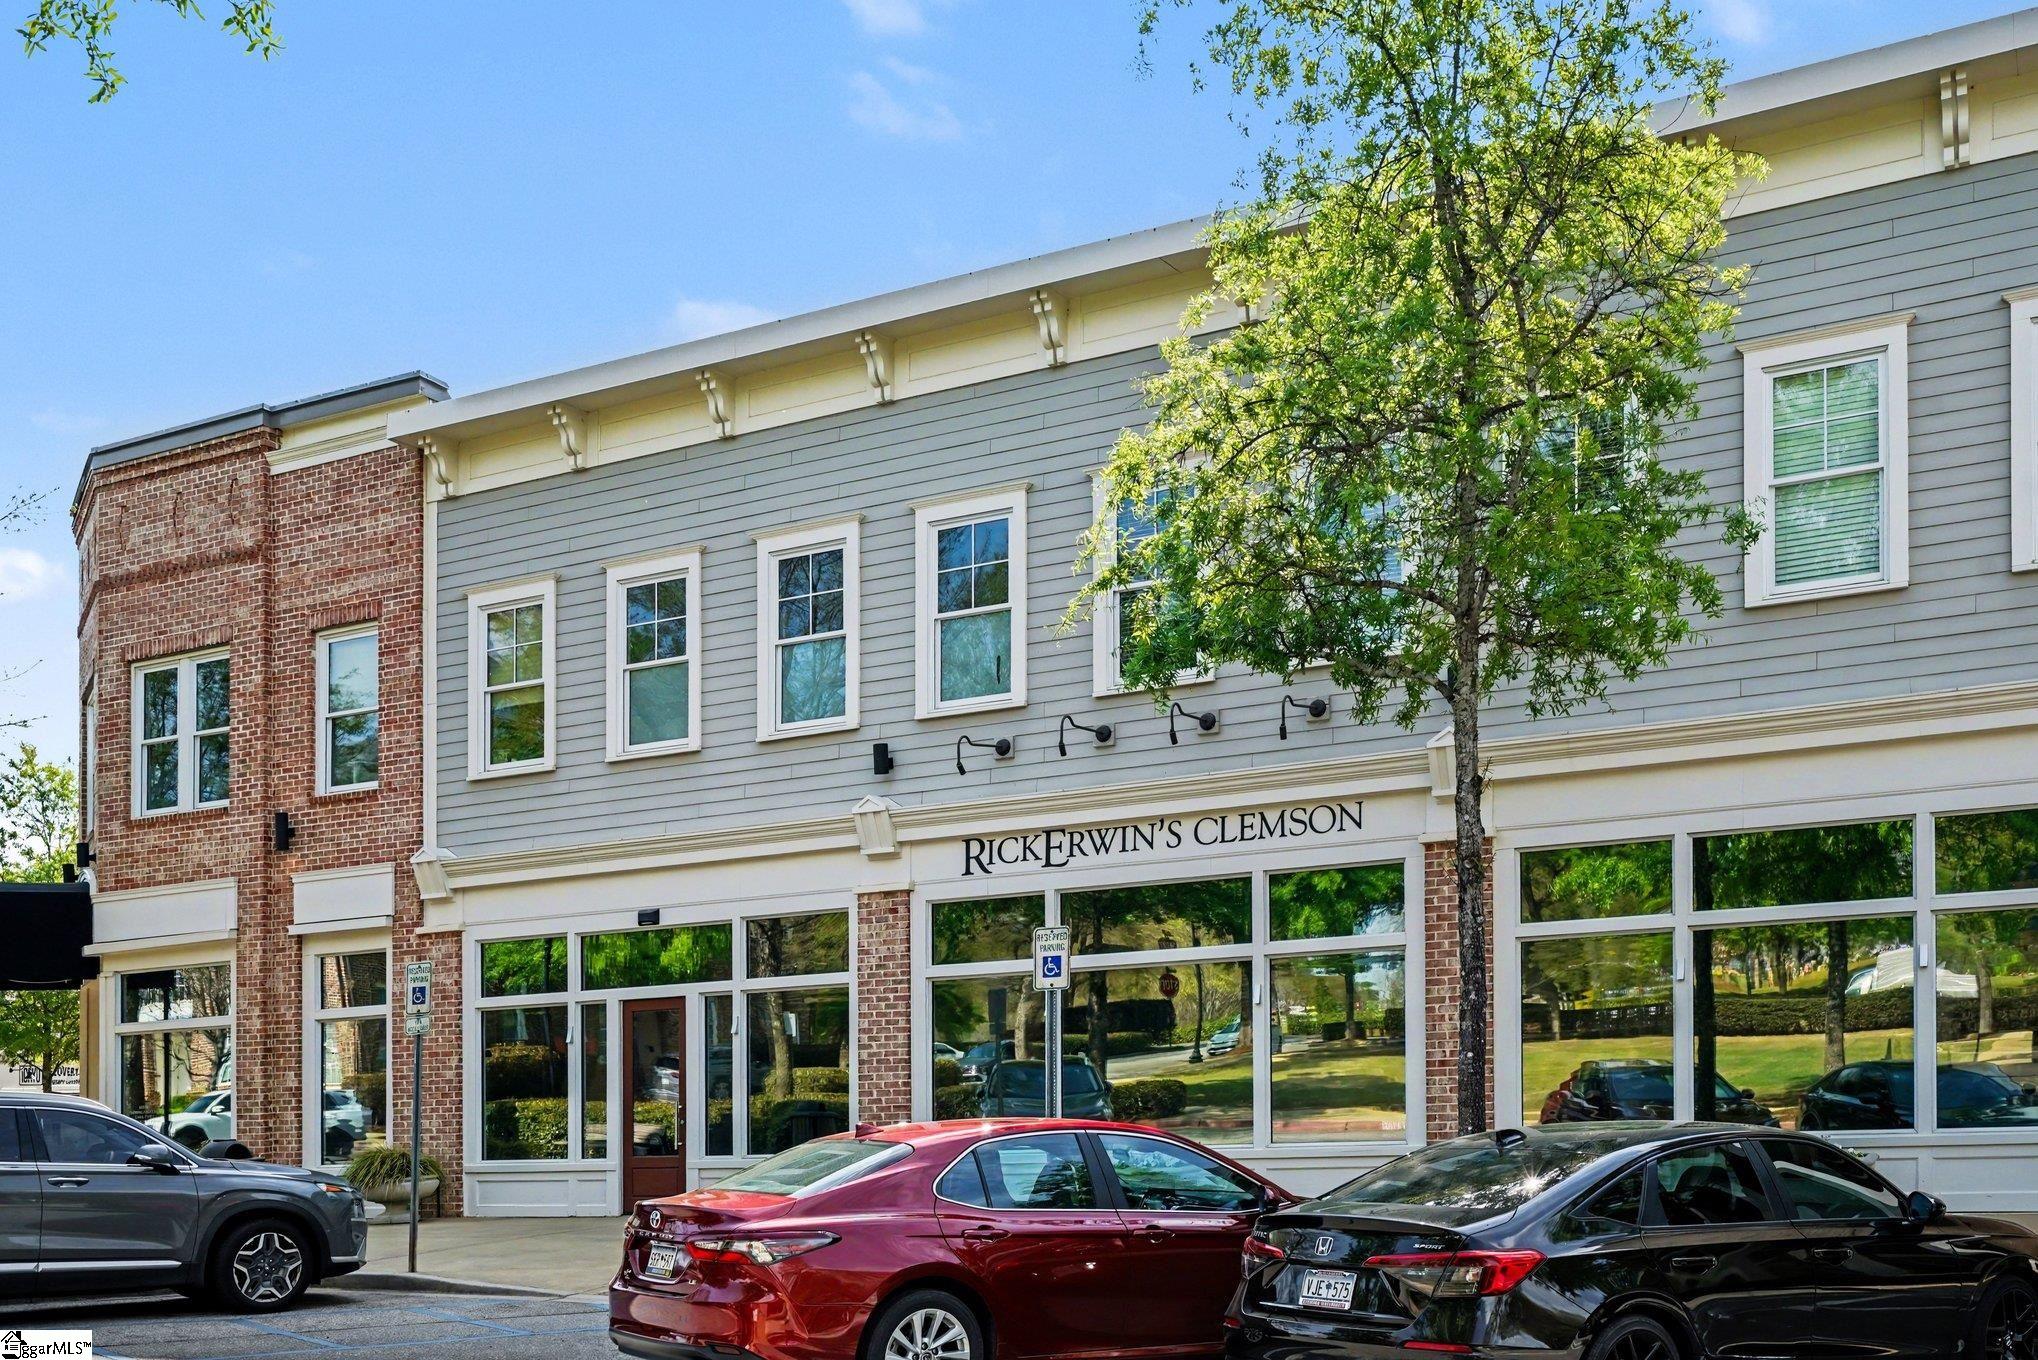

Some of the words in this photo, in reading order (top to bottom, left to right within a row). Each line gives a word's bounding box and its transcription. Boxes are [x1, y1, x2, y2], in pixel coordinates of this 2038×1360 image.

[1193, 801, 1365, 846] CLEMSON
[1036, 932, 1068, 942] RESERVED
[1040, 943, 1066, 952] PARKING
[1307, 1279, 1325, 1297] VJE
[1332, 1281, 1351, 1299] 575
